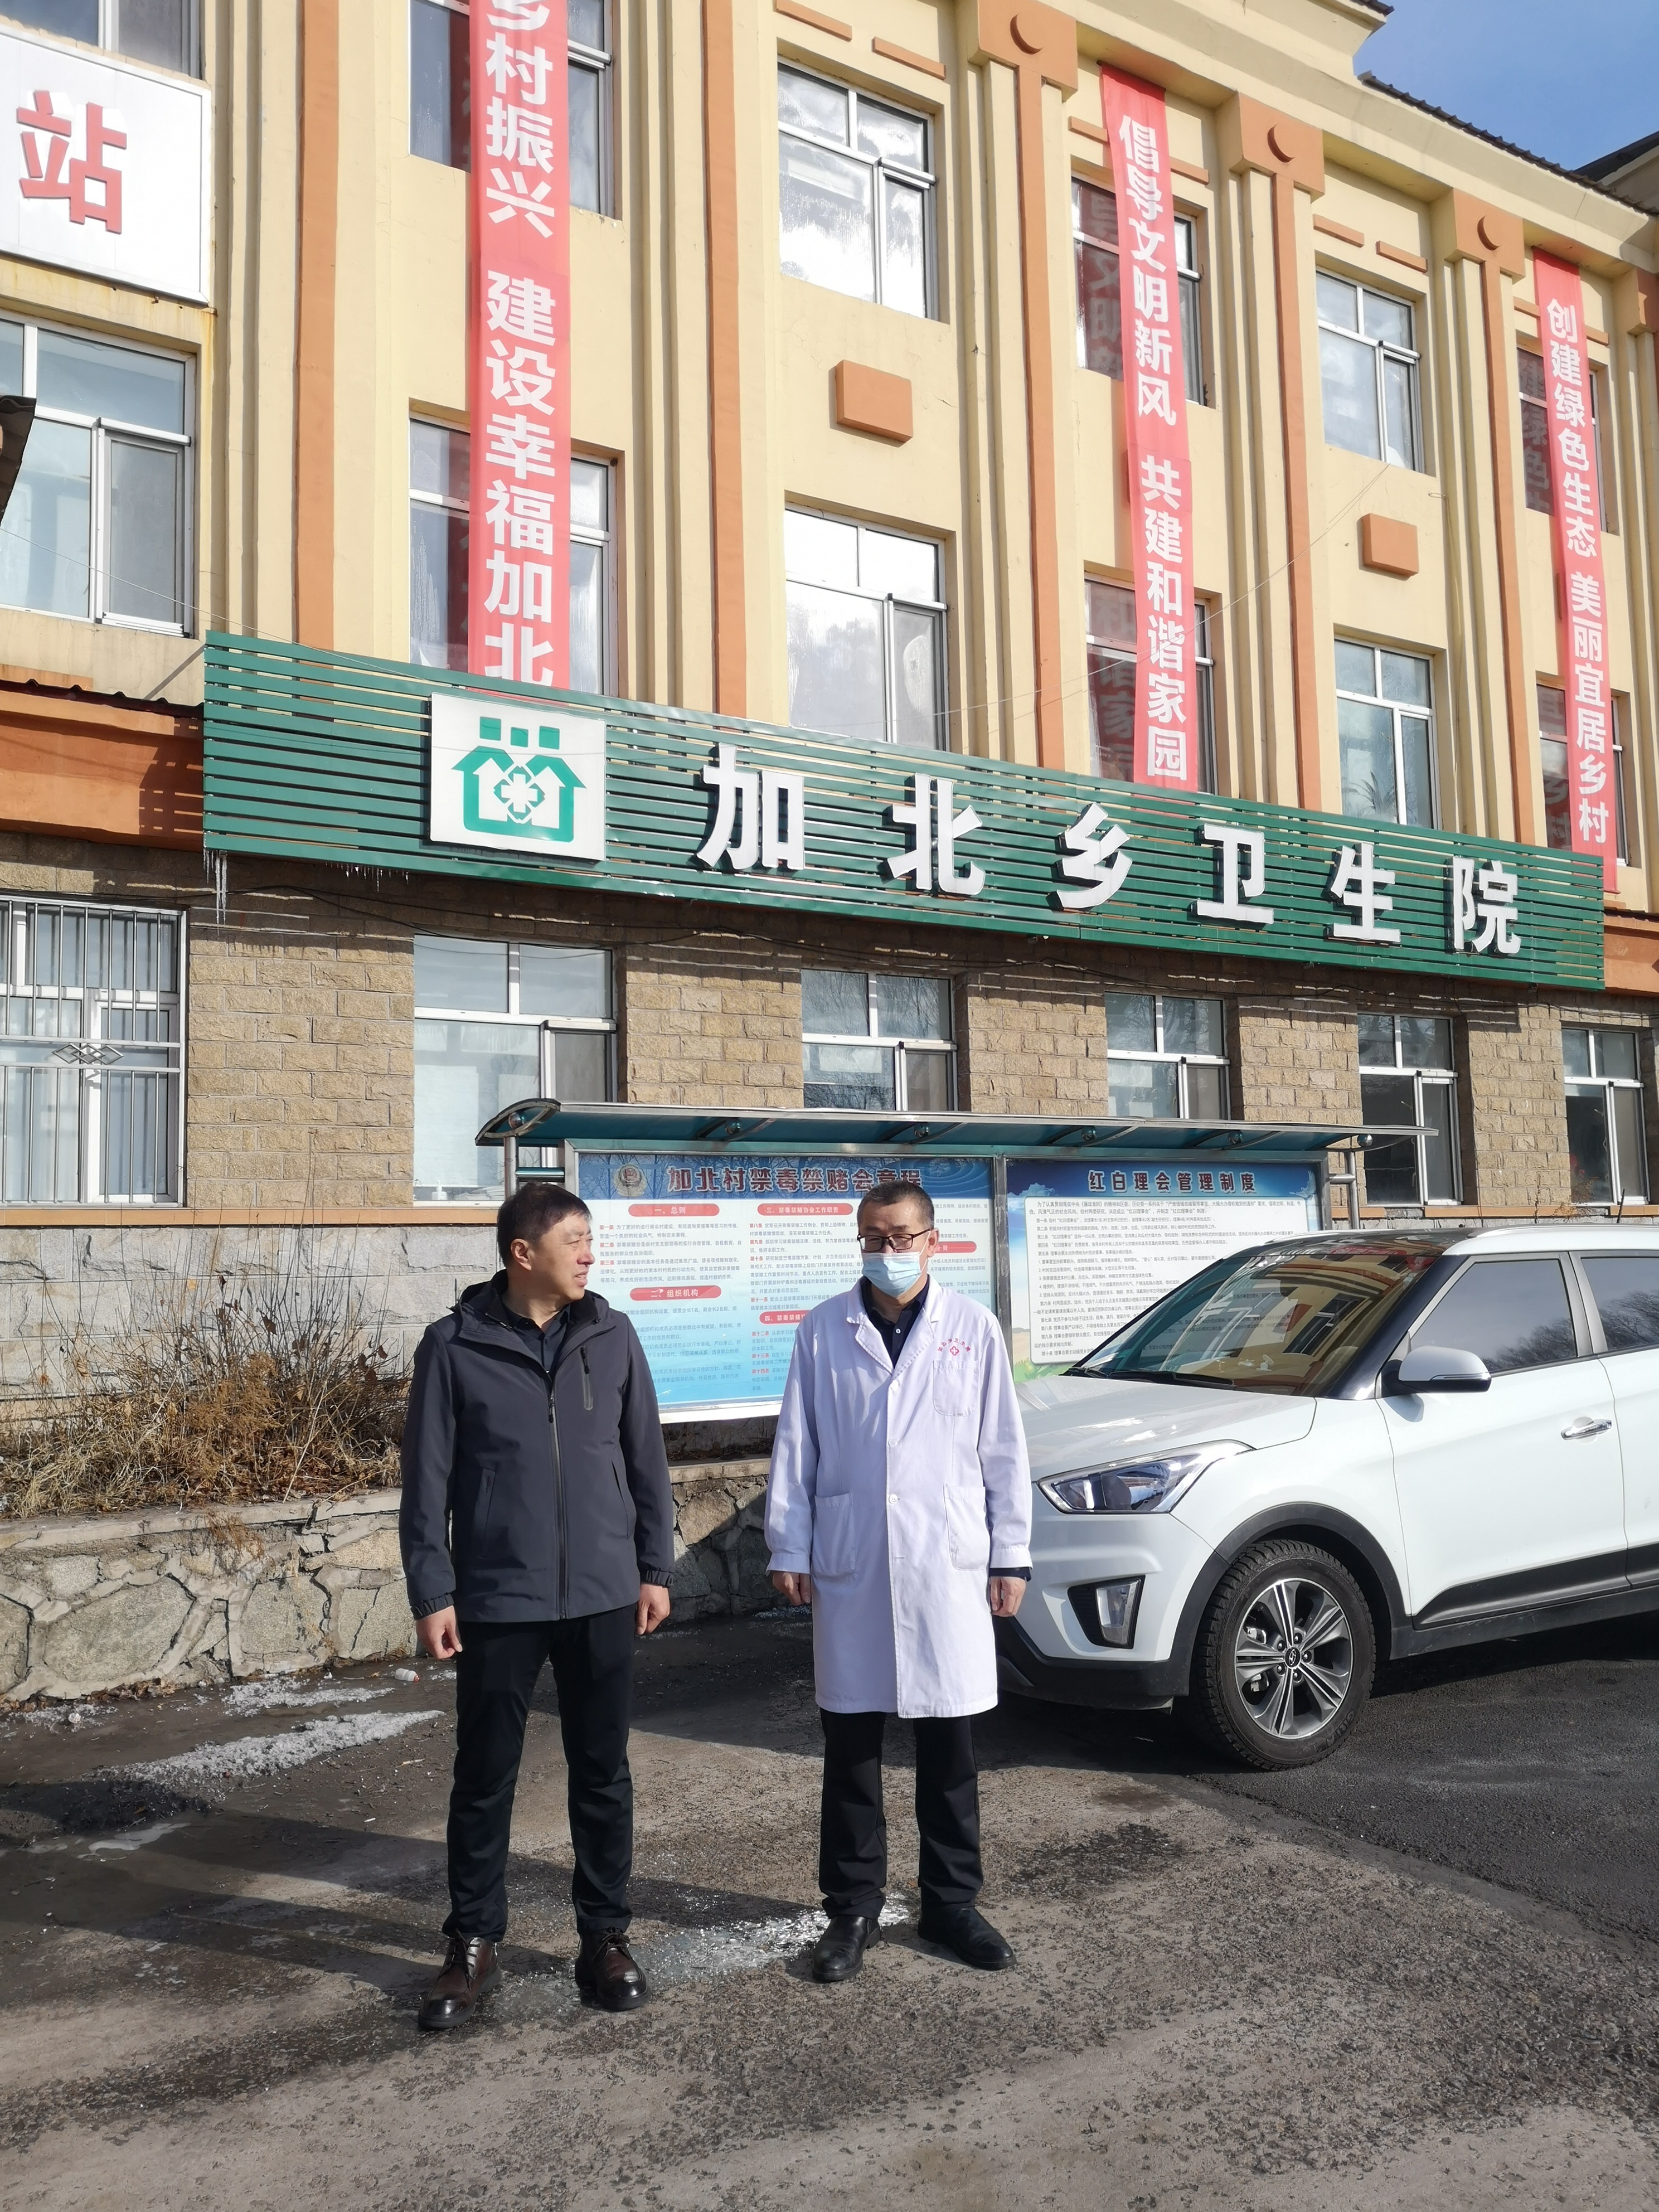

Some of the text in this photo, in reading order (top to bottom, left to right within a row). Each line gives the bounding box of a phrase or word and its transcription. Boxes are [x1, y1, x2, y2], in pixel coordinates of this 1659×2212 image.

[16, 89, 127, 235] 站
[484, 269, 556, 687] 建设幸福加北
[1118, 114, 1187, 781] 倡导文明新风 共建和谐家园
[1547, 298, 1609, 843] 创建绿色生态 美丽宜居乡村
[695, 742, 1521, 955] 加北乡卫生院
[1088, 1170, 1256, 1193] 红白理会管理制度
